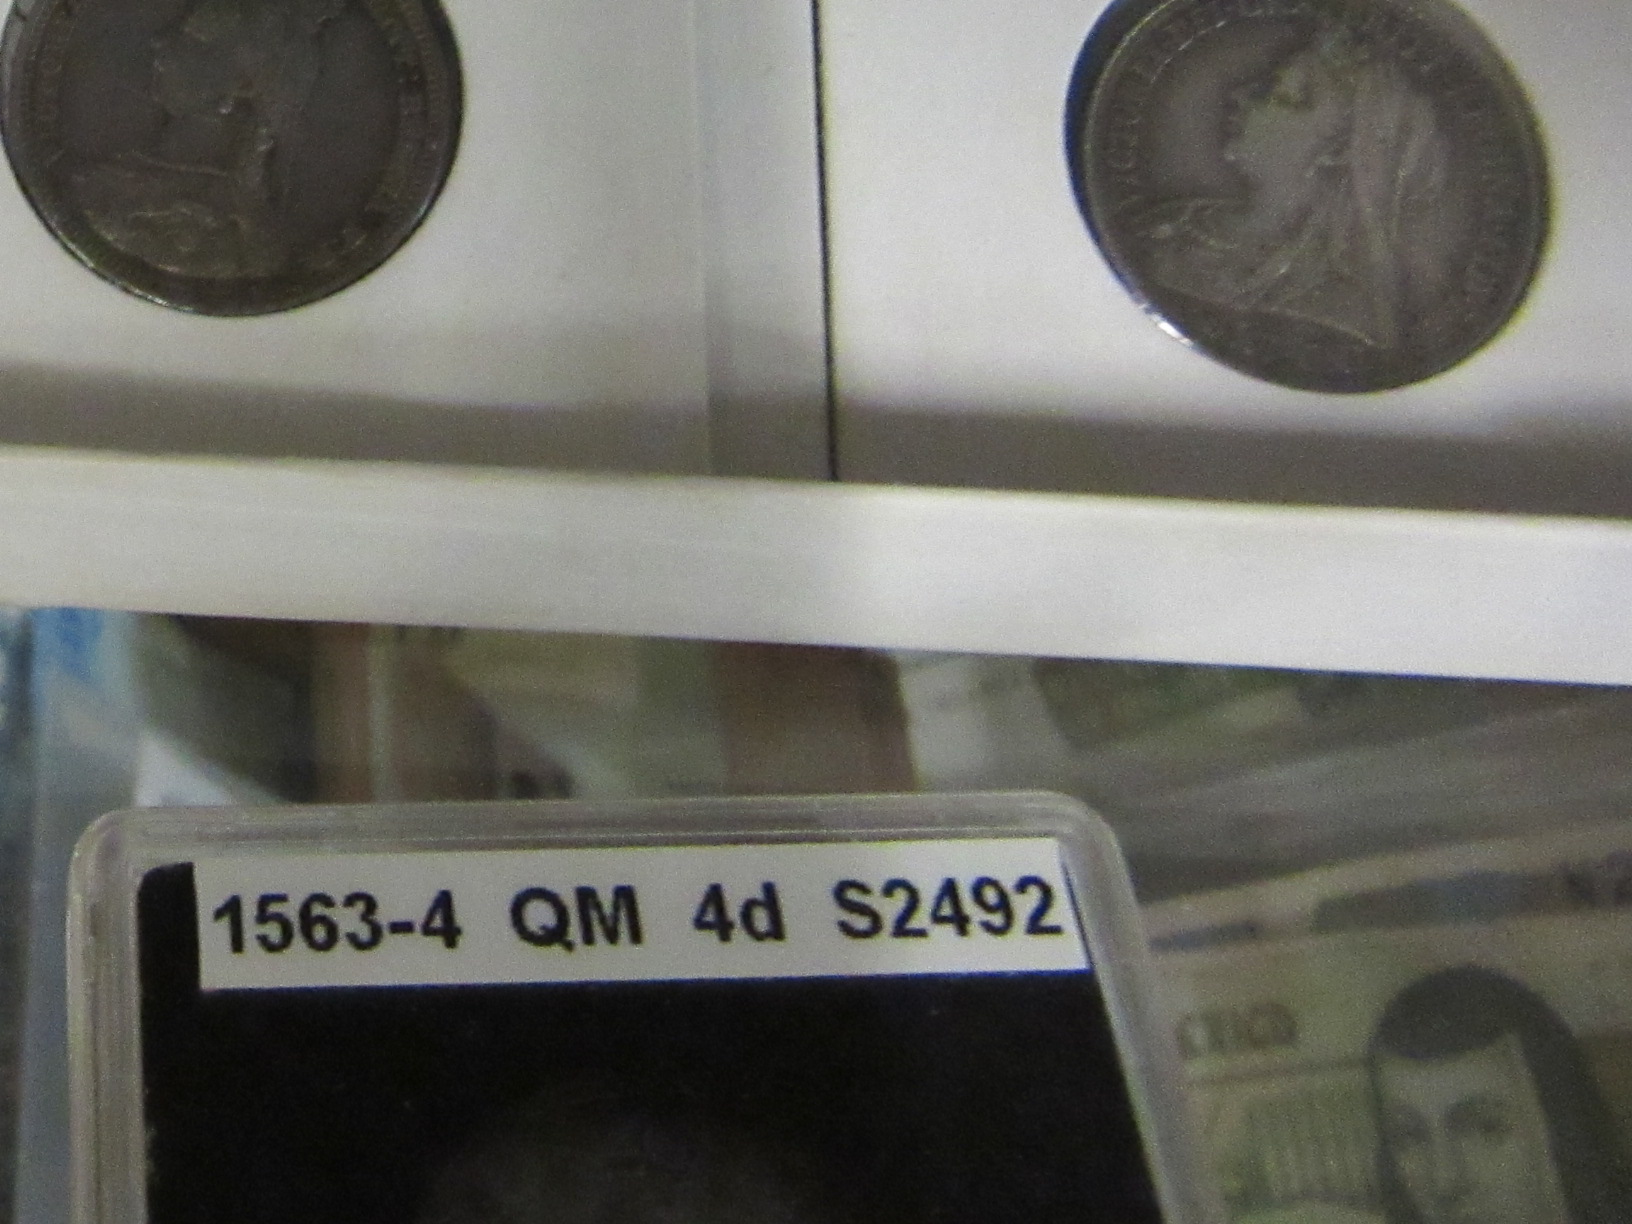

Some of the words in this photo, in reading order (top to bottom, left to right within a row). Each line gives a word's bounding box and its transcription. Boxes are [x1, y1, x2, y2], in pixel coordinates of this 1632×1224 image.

[213, 889, 462, 955] 1563-4
[509, 885, 644, 953] QM
[693, 881, 786, 944] 4d
[833, 876, 1063, 940] S2492
